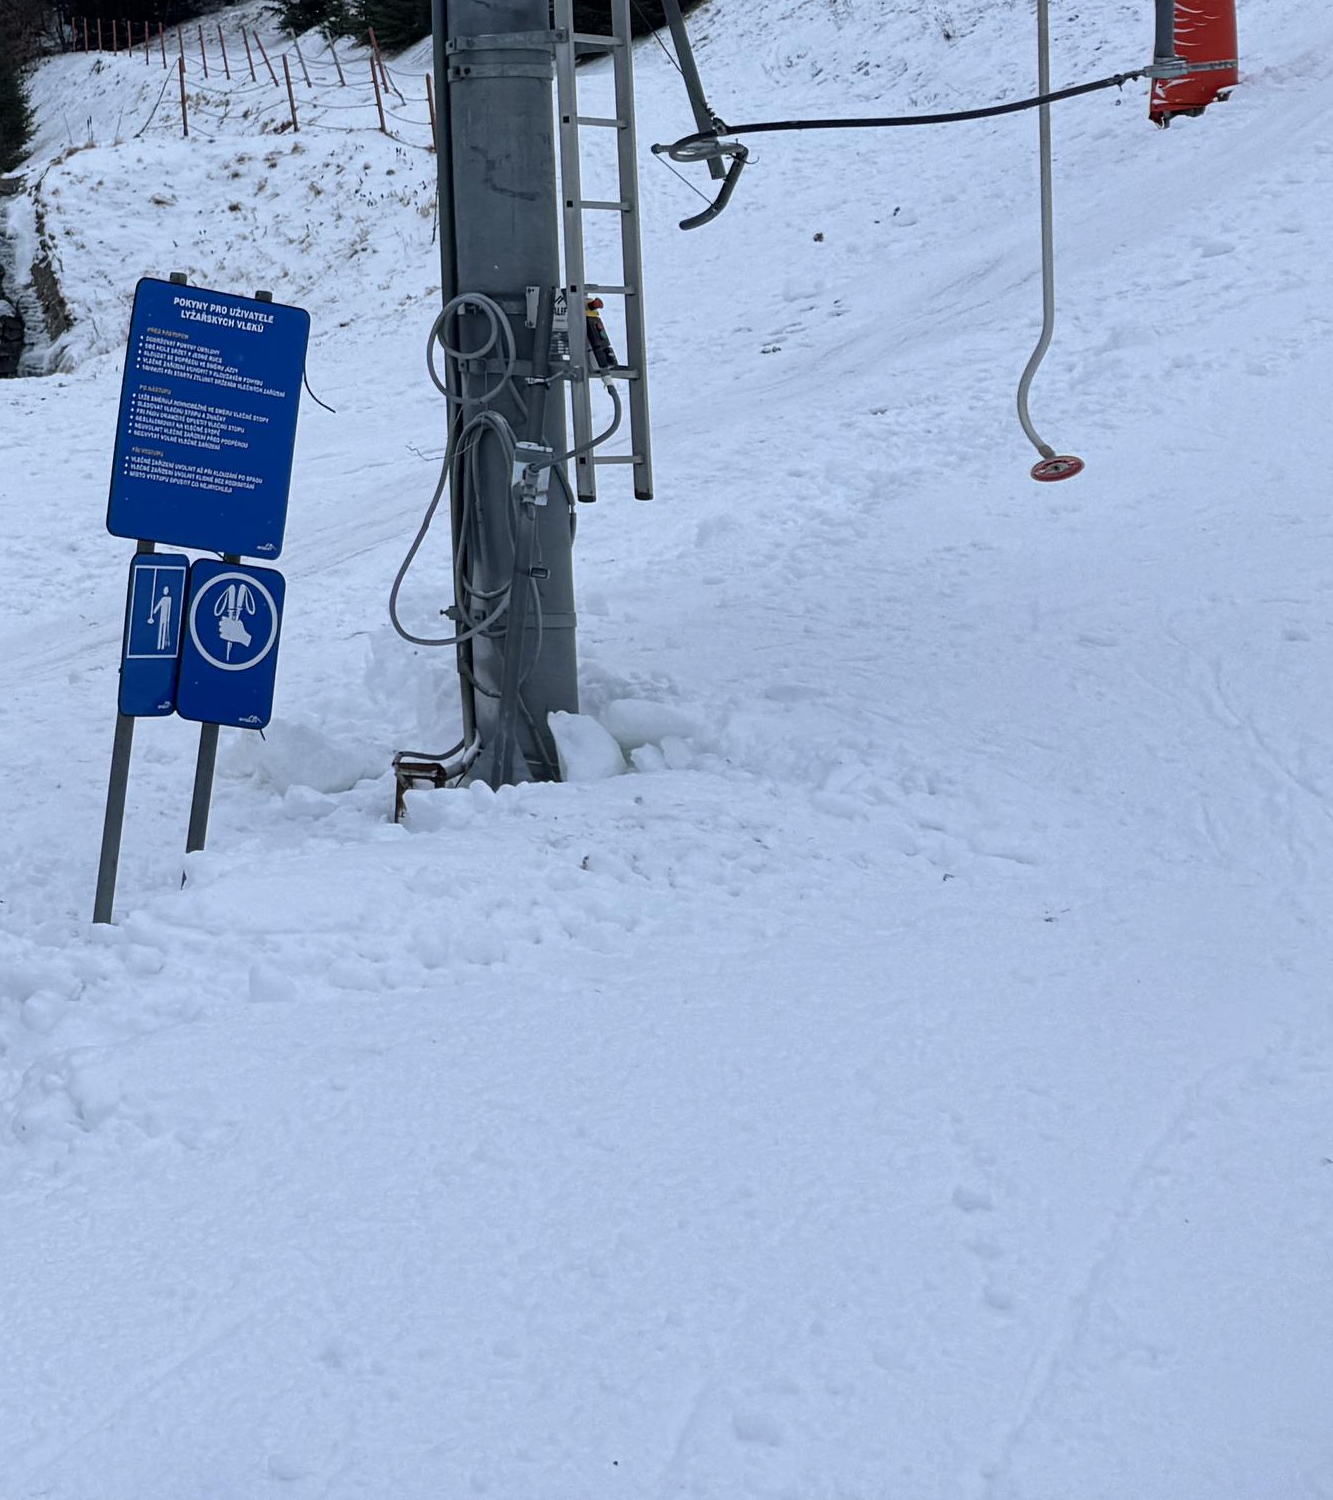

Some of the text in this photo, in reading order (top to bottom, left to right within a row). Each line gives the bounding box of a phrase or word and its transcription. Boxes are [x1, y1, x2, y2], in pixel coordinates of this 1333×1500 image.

[173, 296, 274, 325] POKYNY PRO UŽIVATELE
[181, 309, 264, 334] LYŽAŘSKÝCH VLEKŮ
